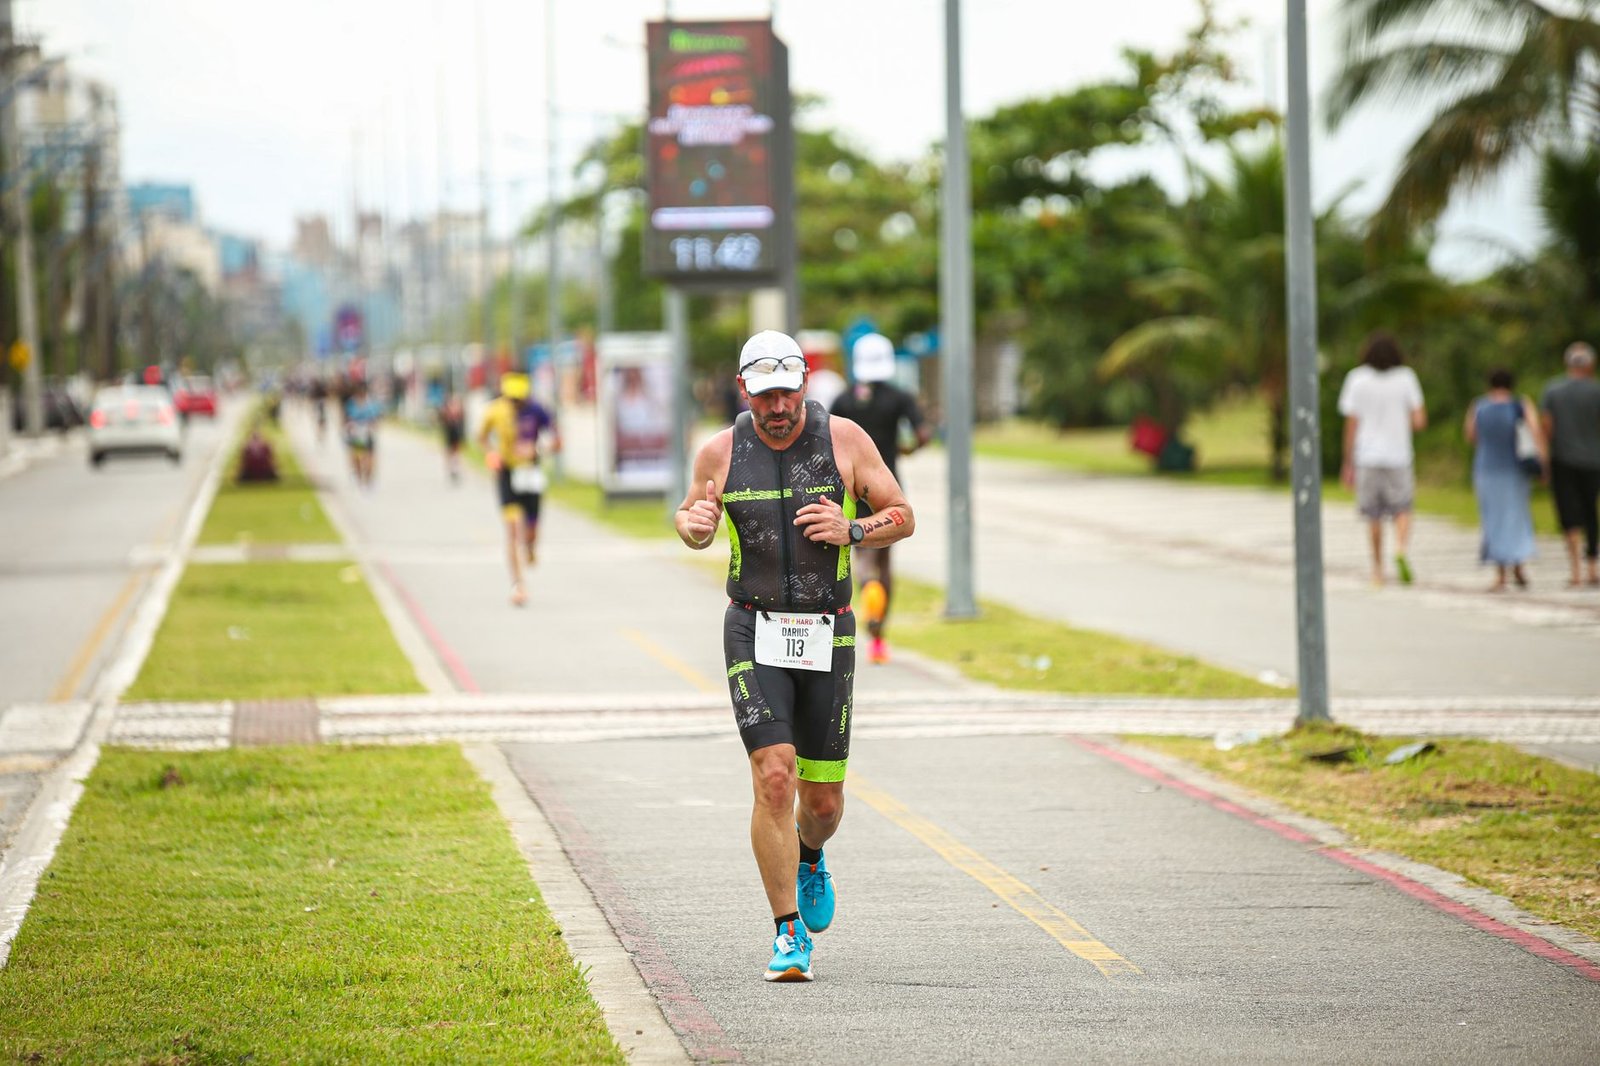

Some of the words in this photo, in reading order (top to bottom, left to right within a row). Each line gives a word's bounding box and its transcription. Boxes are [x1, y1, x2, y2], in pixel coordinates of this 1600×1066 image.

[780, 617, 790, 625] TRI
[782, 627, 809, 637] DARIUS
[786, 639, 805, 657] 113
